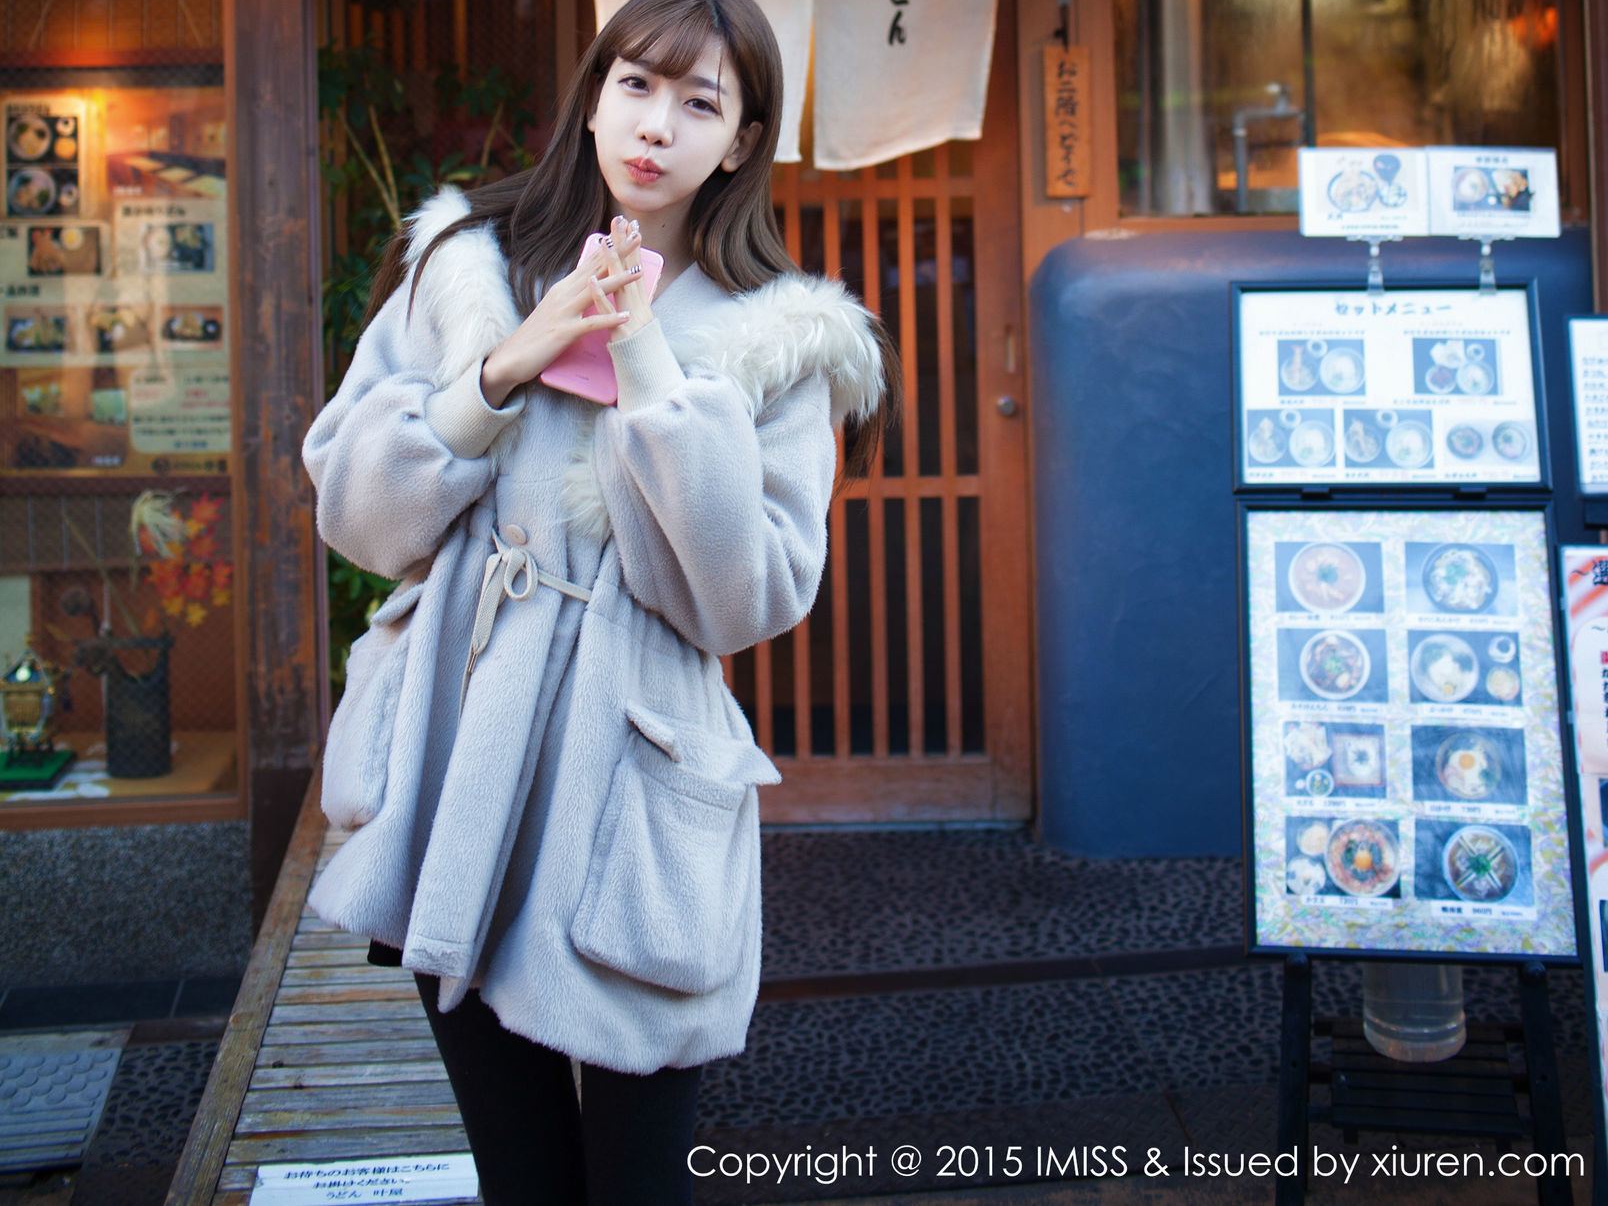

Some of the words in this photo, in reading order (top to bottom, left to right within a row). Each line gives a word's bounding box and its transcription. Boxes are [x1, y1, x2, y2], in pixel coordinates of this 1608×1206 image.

[1335, 302, 1453, 316] セットメニュー
[286, 1164, 449, 1179] お待ちのお客様はこちらに
[326, 1190, 361, 1200] うどん
